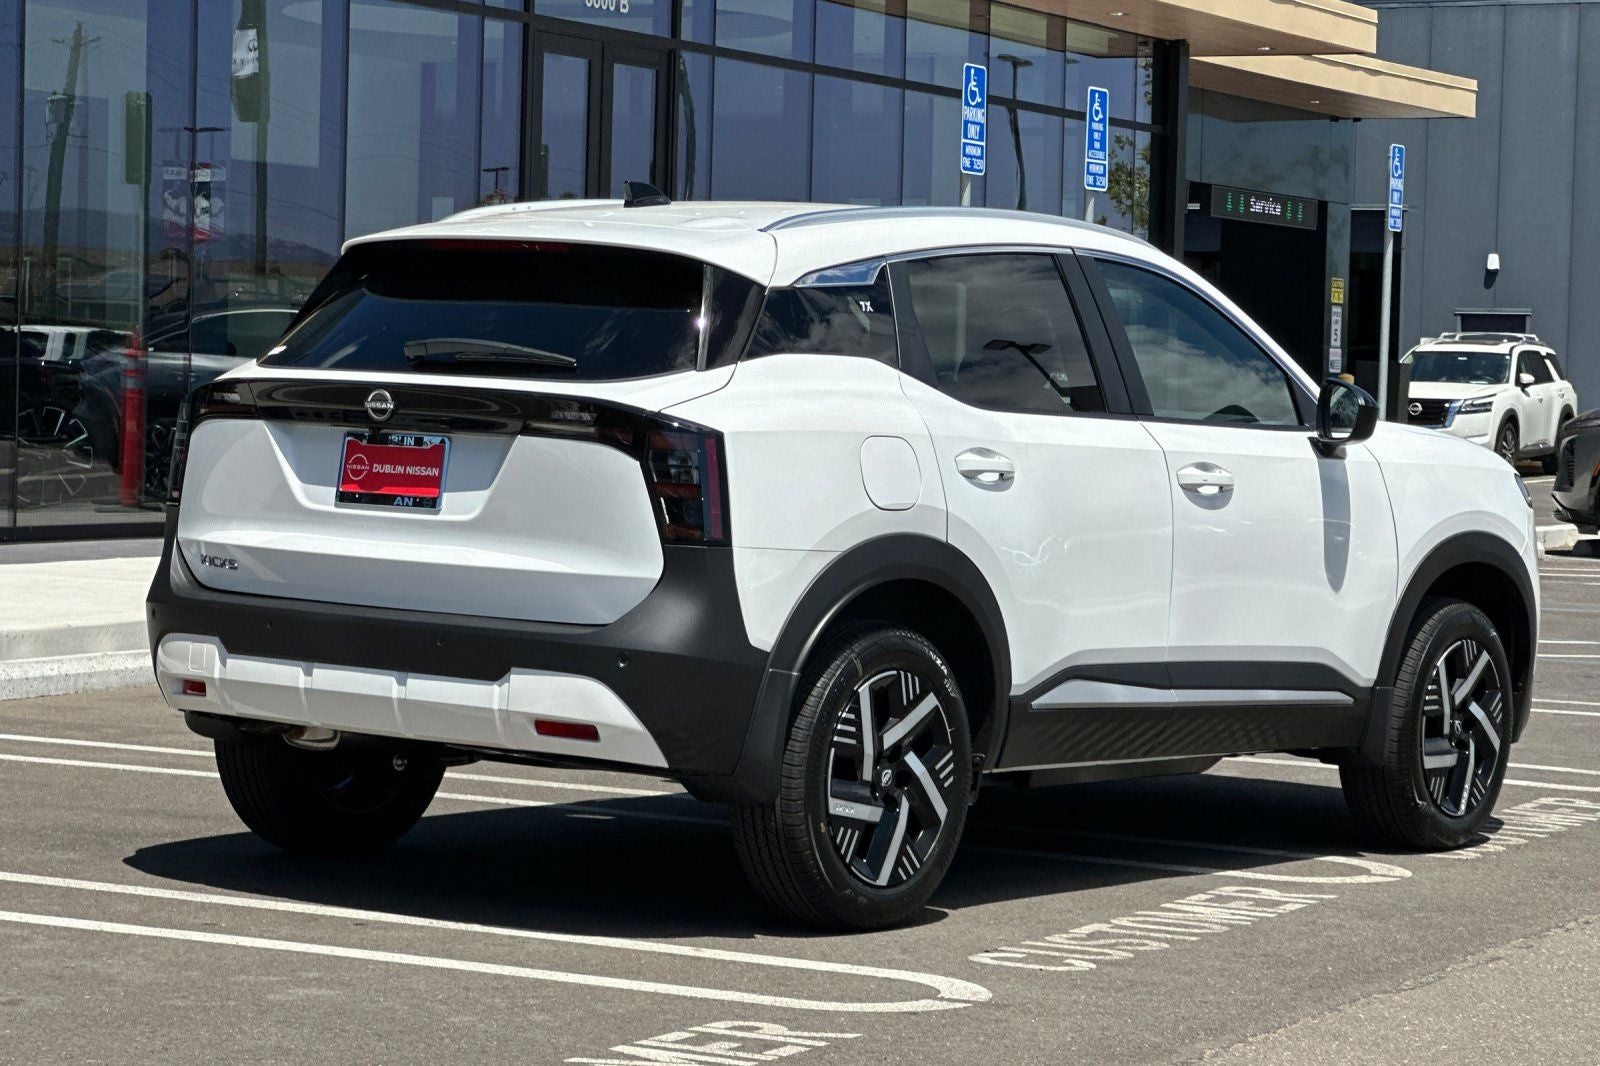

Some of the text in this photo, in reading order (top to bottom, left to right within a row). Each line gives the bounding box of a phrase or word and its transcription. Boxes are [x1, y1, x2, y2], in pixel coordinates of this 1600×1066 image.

[963, 106, 985, 124] PARKING
[967, 124, 981, 139] ONLY
[1250, 196, 1281, 215] Service
[365, 401, 394, 409] NISSAN
[372, 463, 439, 477] DUBLIN NISSAN
[967, 886, 1338, 971] CUSTOMER
